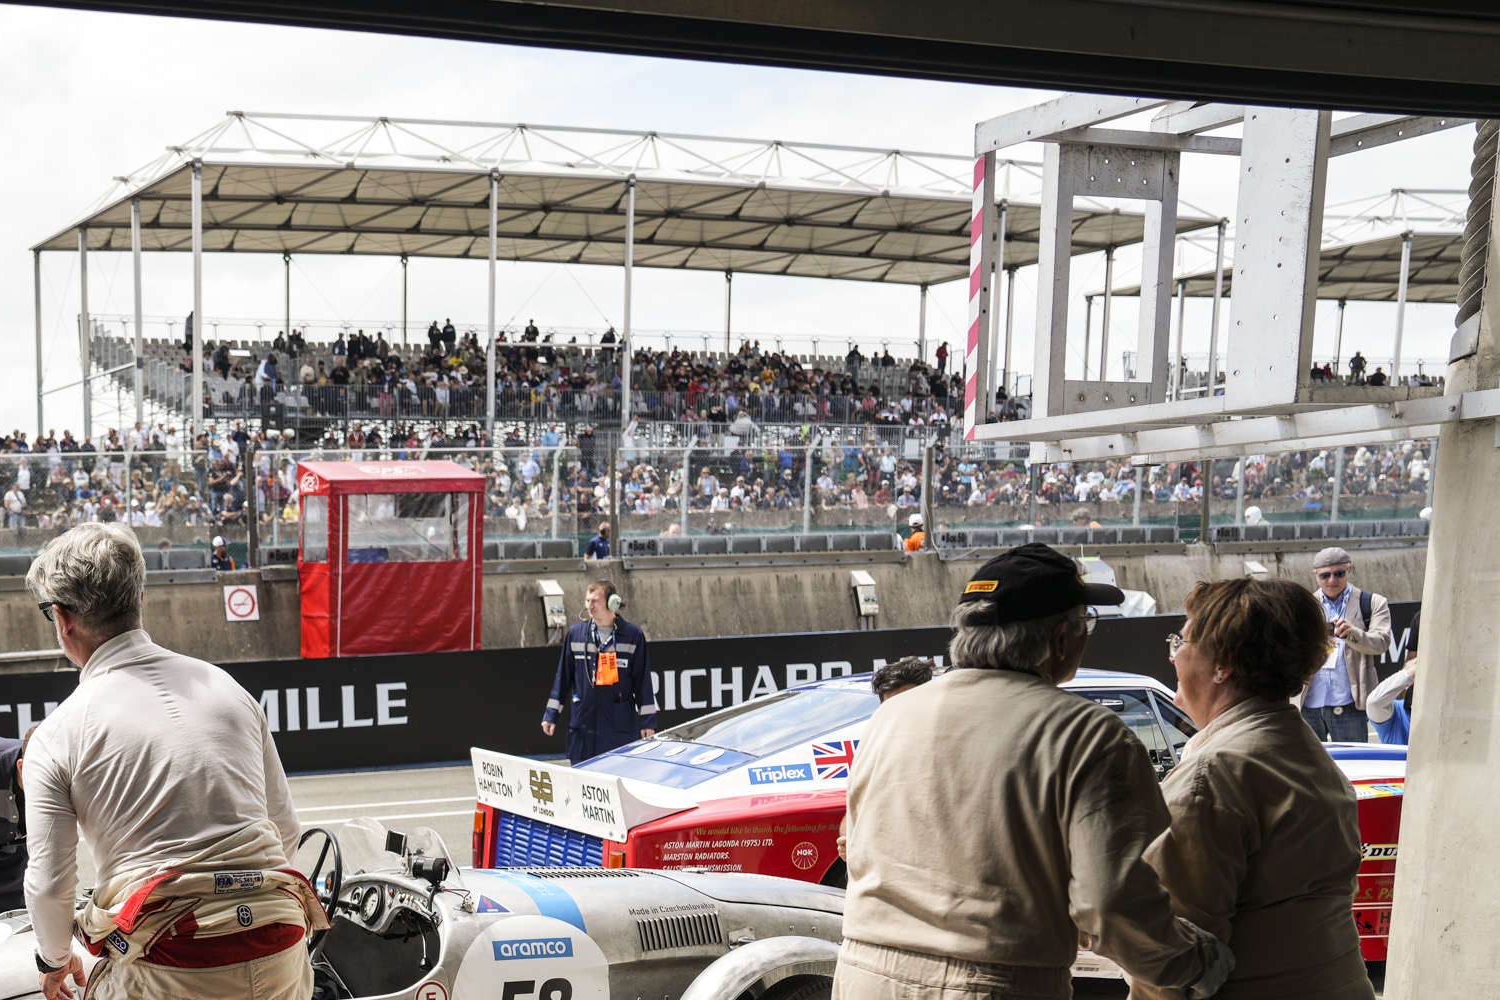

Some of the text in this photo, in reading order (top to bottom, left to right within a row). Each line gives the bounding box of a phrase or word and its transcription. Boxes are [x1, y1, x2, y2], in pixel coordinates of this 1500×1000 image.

[633, 540, 645, 551] Box
[276, 550, 289, 561] Box
[482, 761, 503, 779] ROBIN
[752, 765, 806, 783] Triplex
[478, 778, 513, 798] HAMILTON
[582, 784, 610, 804] ASTON
[533, 806, 555, 818] OF LONDON
[582, 803, 615, 825] MARTIN
[695, 827, 707, 836] We
[708, 827, 729, 835] would
[730, 826, 744, 835] like
[753, 825, 772, 834] thank
[774, 825, 784, 833] the
[784, 824, 816, 834] following
[815, 824, 827, 834] for
[664, 838, 774, 850] ASTON MARTIN LAGONDA (1975) LTD.
[663, 851, 730, 861] MARSTON RADIATORS.
[1369, 847, 1398, 857] DU
[1354, 888, 1373, 900] .S.
[629, 902, 716, 916] Made in Czechoslovakia
[500, 941, 566, 957] aramco
